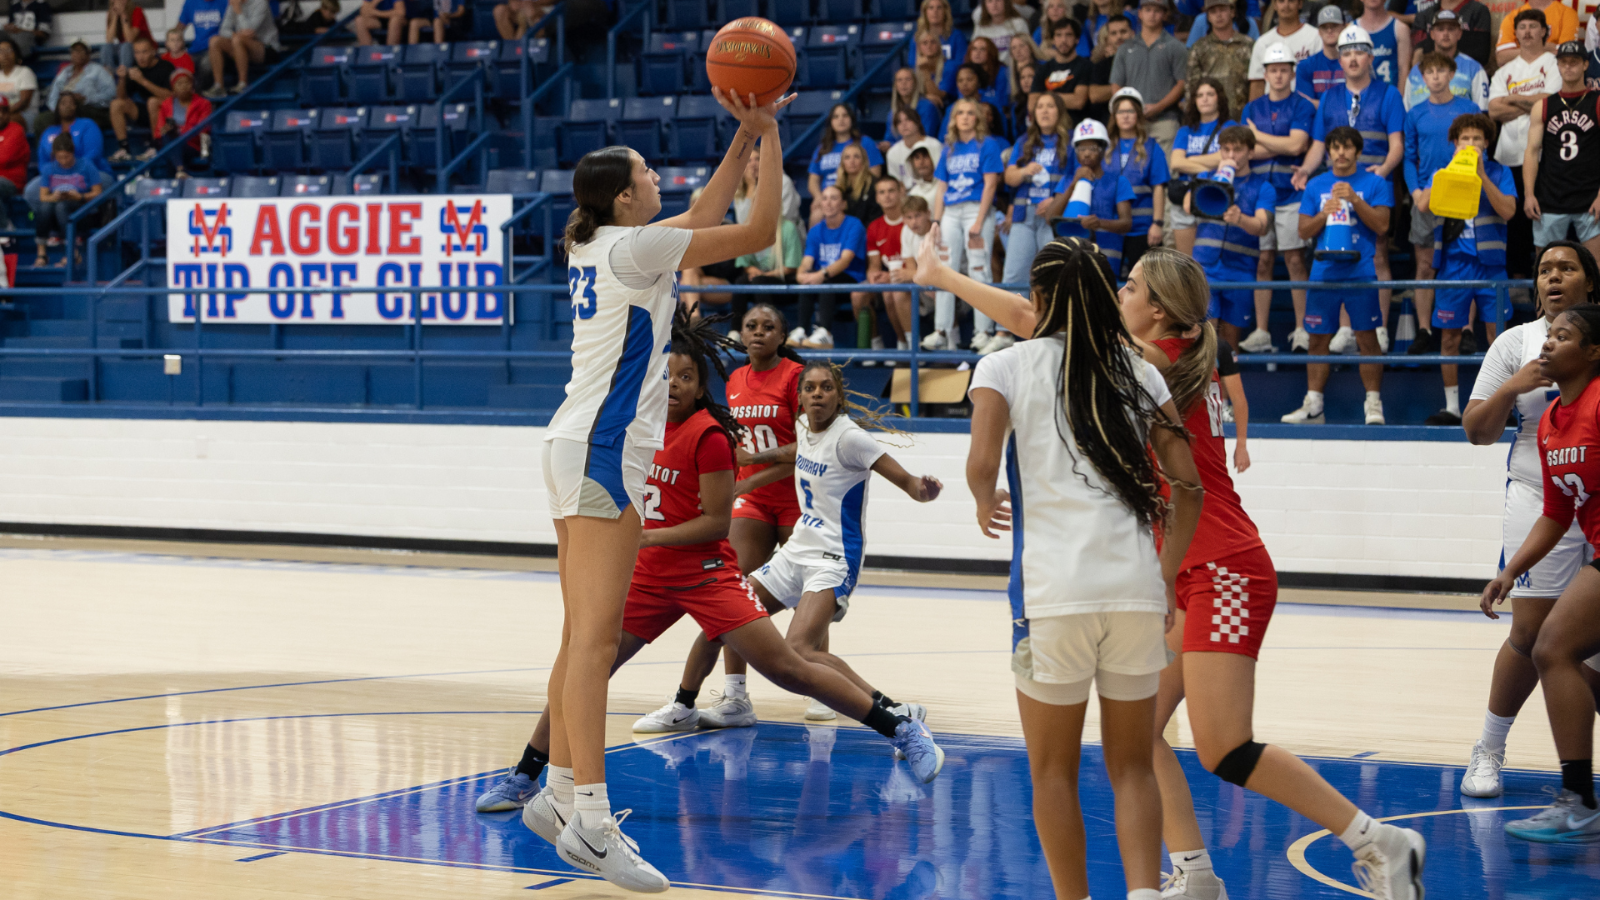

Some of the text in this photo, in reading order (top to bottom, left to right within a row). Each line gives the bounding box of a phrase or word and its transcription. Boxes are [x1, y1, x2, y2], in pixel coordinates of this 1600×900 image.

[1376, 60, 1392, 83] 4
[1547, 110, 1595, 135] IVERSON
[1559, 130, 1579, 161] 3
[249, 202, 422, 256] AGGIE
[173, 261, 504, 320] TIP OFF CLUB
[569, 265, 597, 320] 23
[729, 424, 778, 454] 30
[1546, 446, 1587, 466] SSATOT
[648, 463, 680, 485] ATOT
[800, 477, 814, 510] 5
[801, 512, 824, 528] ATE
